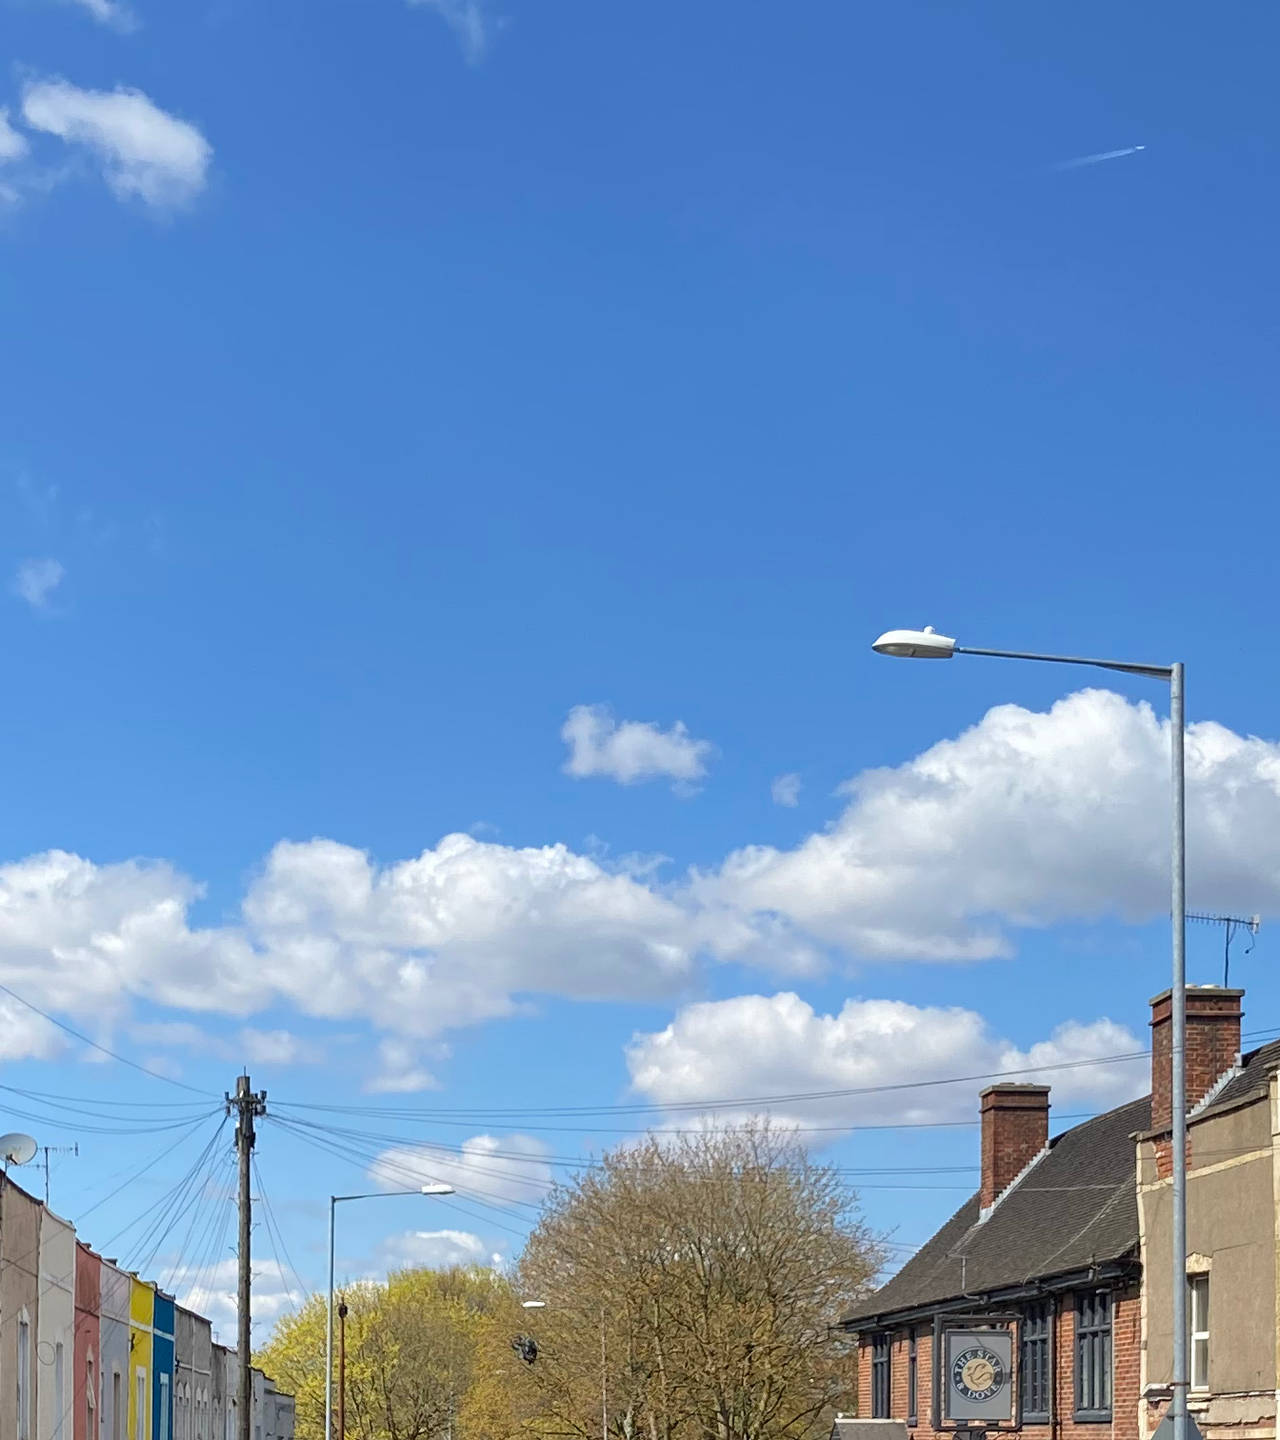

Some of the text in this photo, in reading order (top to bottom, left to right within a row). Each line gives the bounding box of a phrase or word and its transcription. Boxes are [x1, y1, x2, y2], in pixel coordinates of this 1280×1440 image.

[954, 1350, 1001, 1374] THE STAR
[967, 1384, 999, 1399] DOVE
